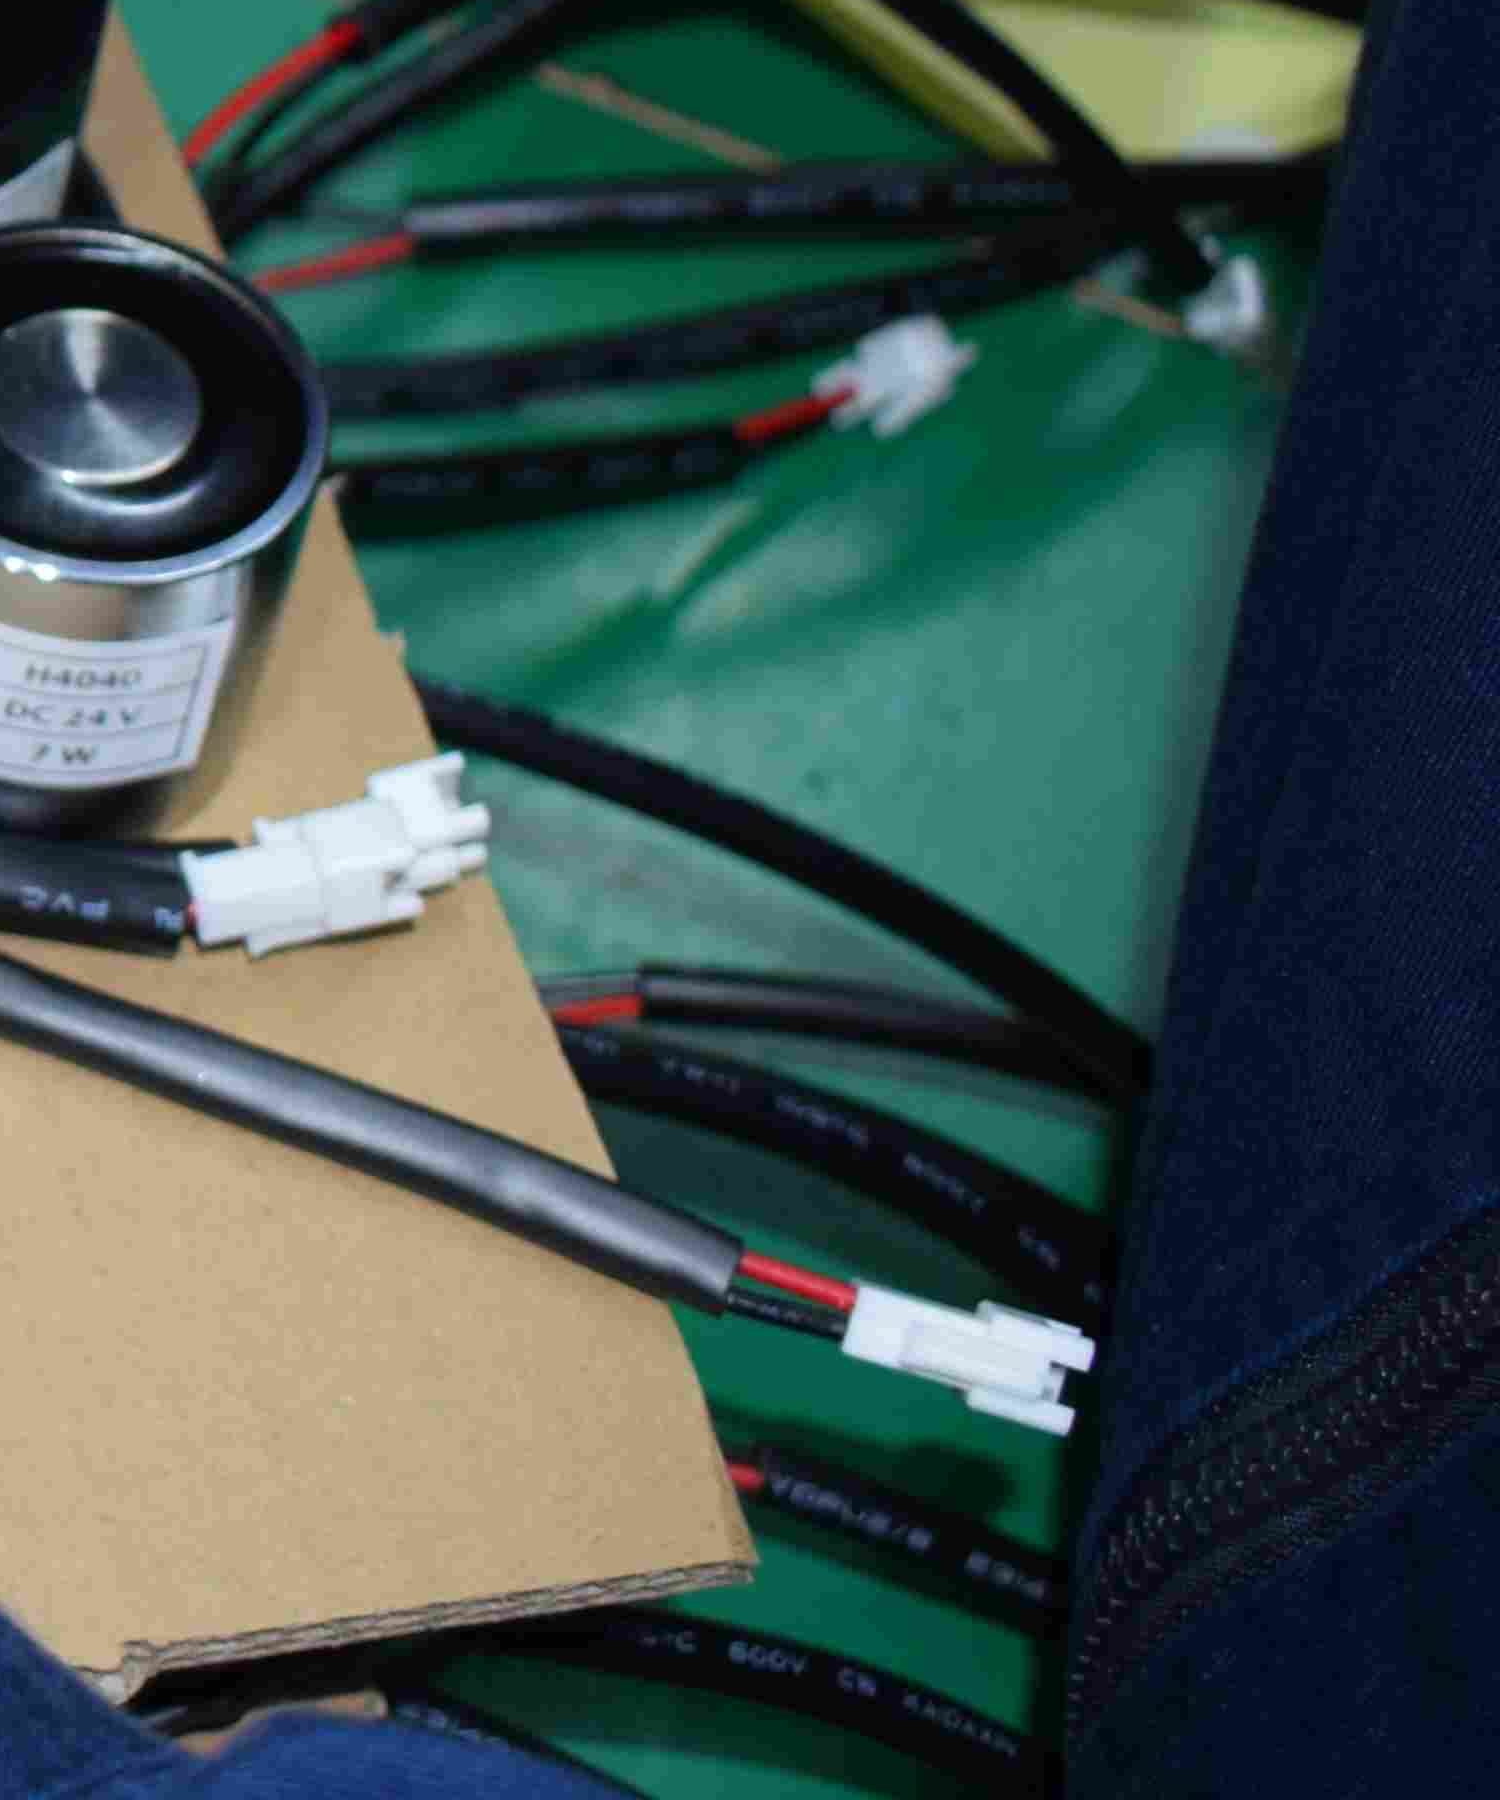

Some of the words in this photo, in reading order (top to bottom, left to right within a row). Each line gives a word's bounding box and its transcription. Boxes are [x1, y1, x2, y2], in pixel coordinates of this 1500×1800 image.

[25, 663, 143, 687] H4040
[3, 699, 54, 723] DC
[63, 706, 107, 728] 24
[118, 703, 143, 724] V
[61, 744, 97, 764] W
